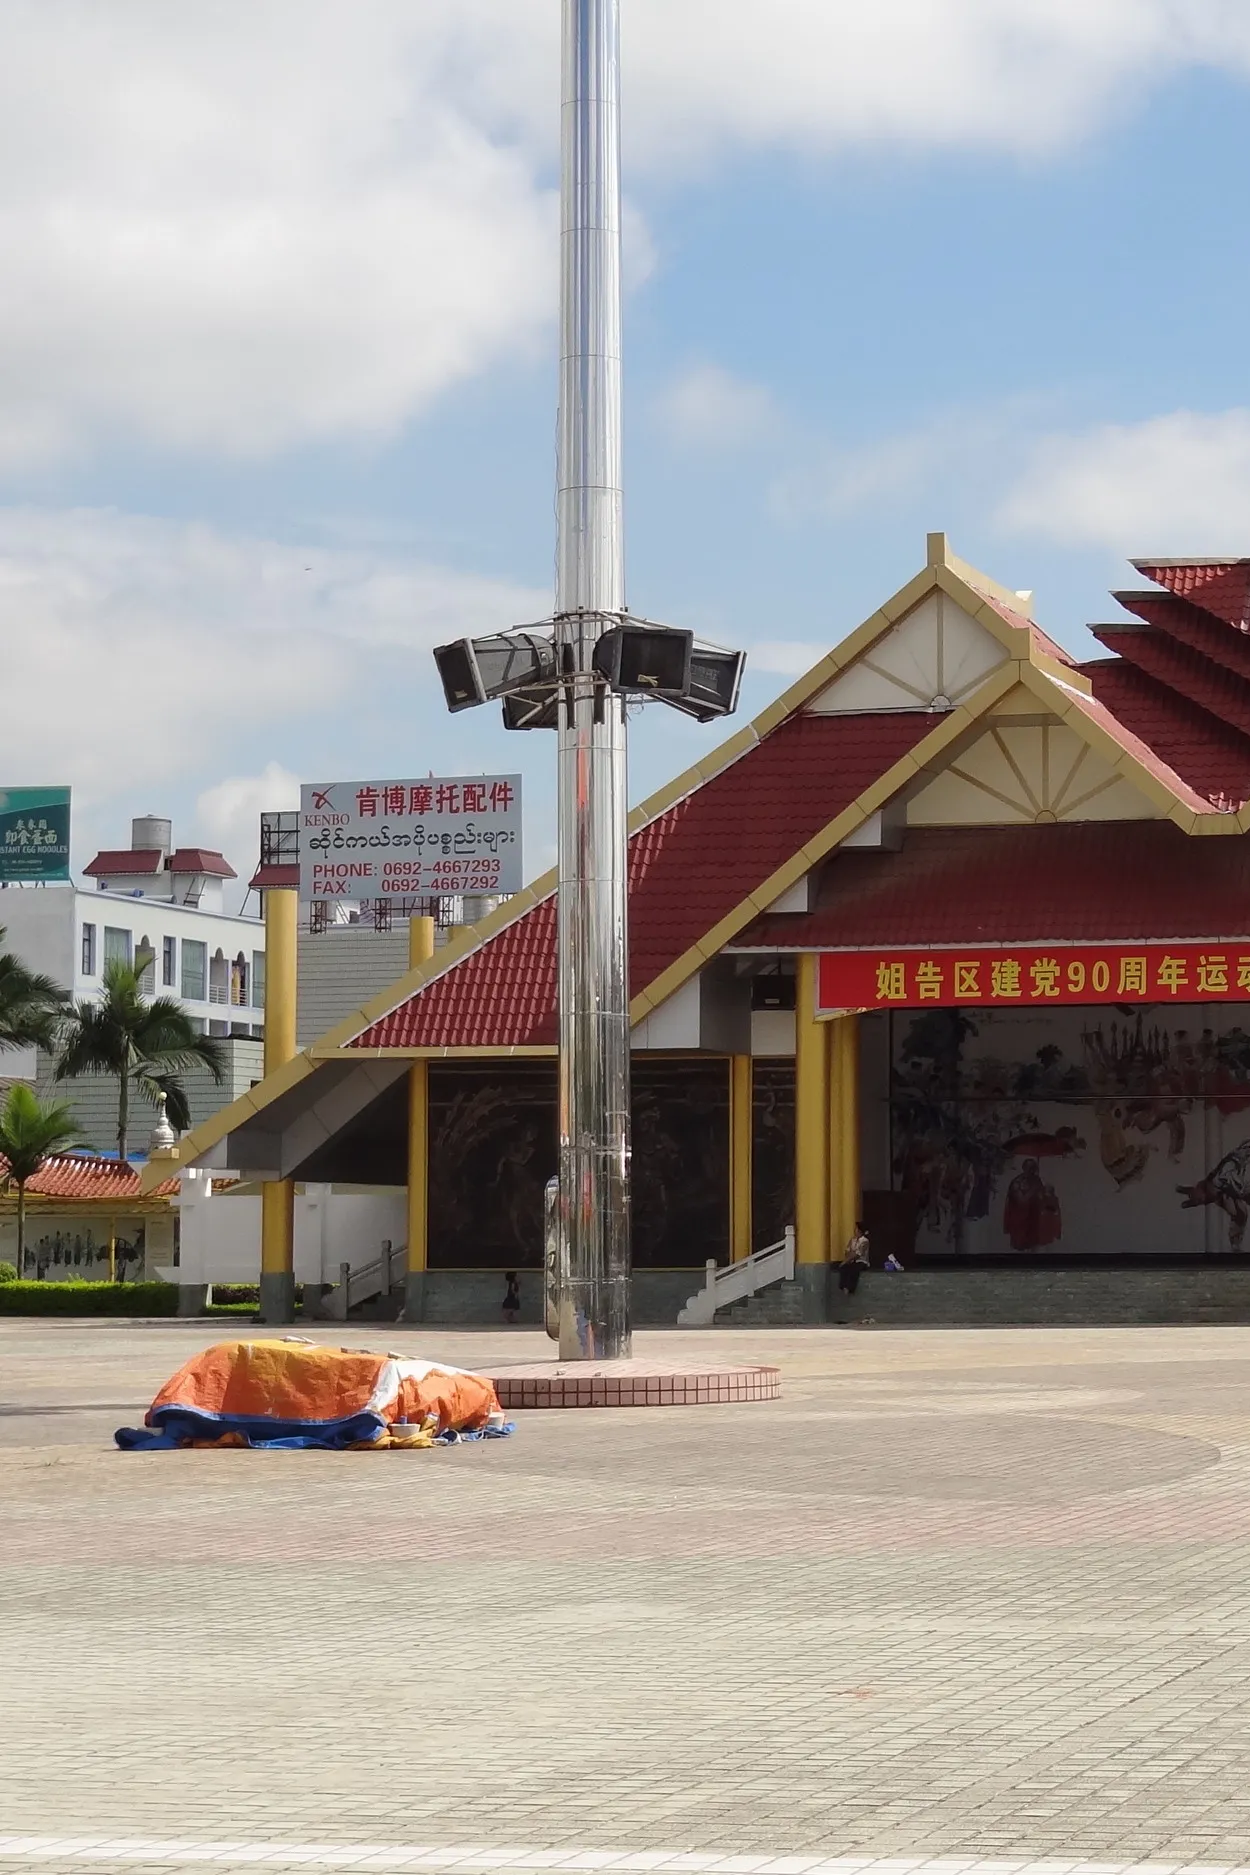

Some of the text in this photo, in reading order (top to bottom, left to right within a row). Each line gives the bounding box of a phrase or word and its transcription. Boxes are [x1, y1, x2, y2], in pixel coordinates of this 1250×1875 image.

[355, 781, 514, 817] 肯博摩托配件
[304, 813, 350, 827] KENBO
[312, 858, 501, 878] PHONE: 0692-4667293
[312, 875, 499, 895] FAX: 0692-4667292
